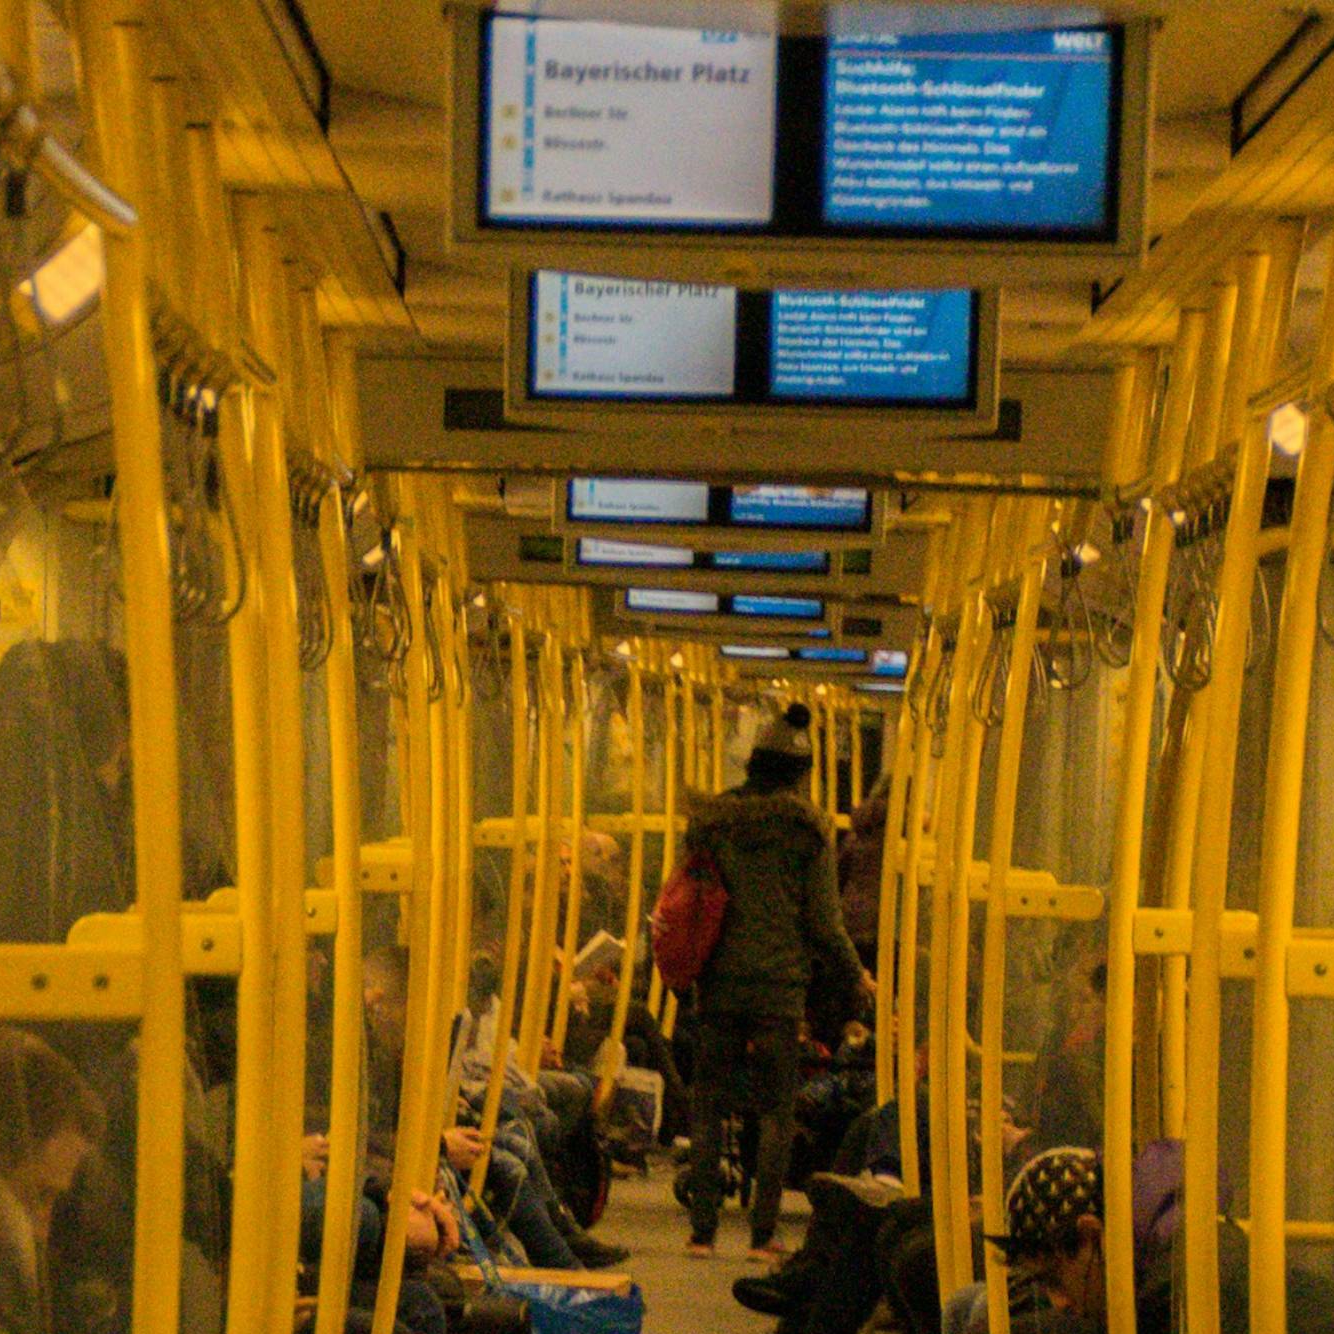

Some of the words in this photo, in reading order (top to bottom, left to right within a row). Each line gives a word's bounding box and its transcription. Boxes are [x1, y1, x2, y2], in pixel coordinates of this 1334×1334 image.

[1053, 32, 1105, 50] WELT
[544, 59, 683, 84] Bayerischer
[692, 62, 753, 84] Platz
[573, 280, 671, 300] Bayerischer
[677, 284, 720, 299] Platz
